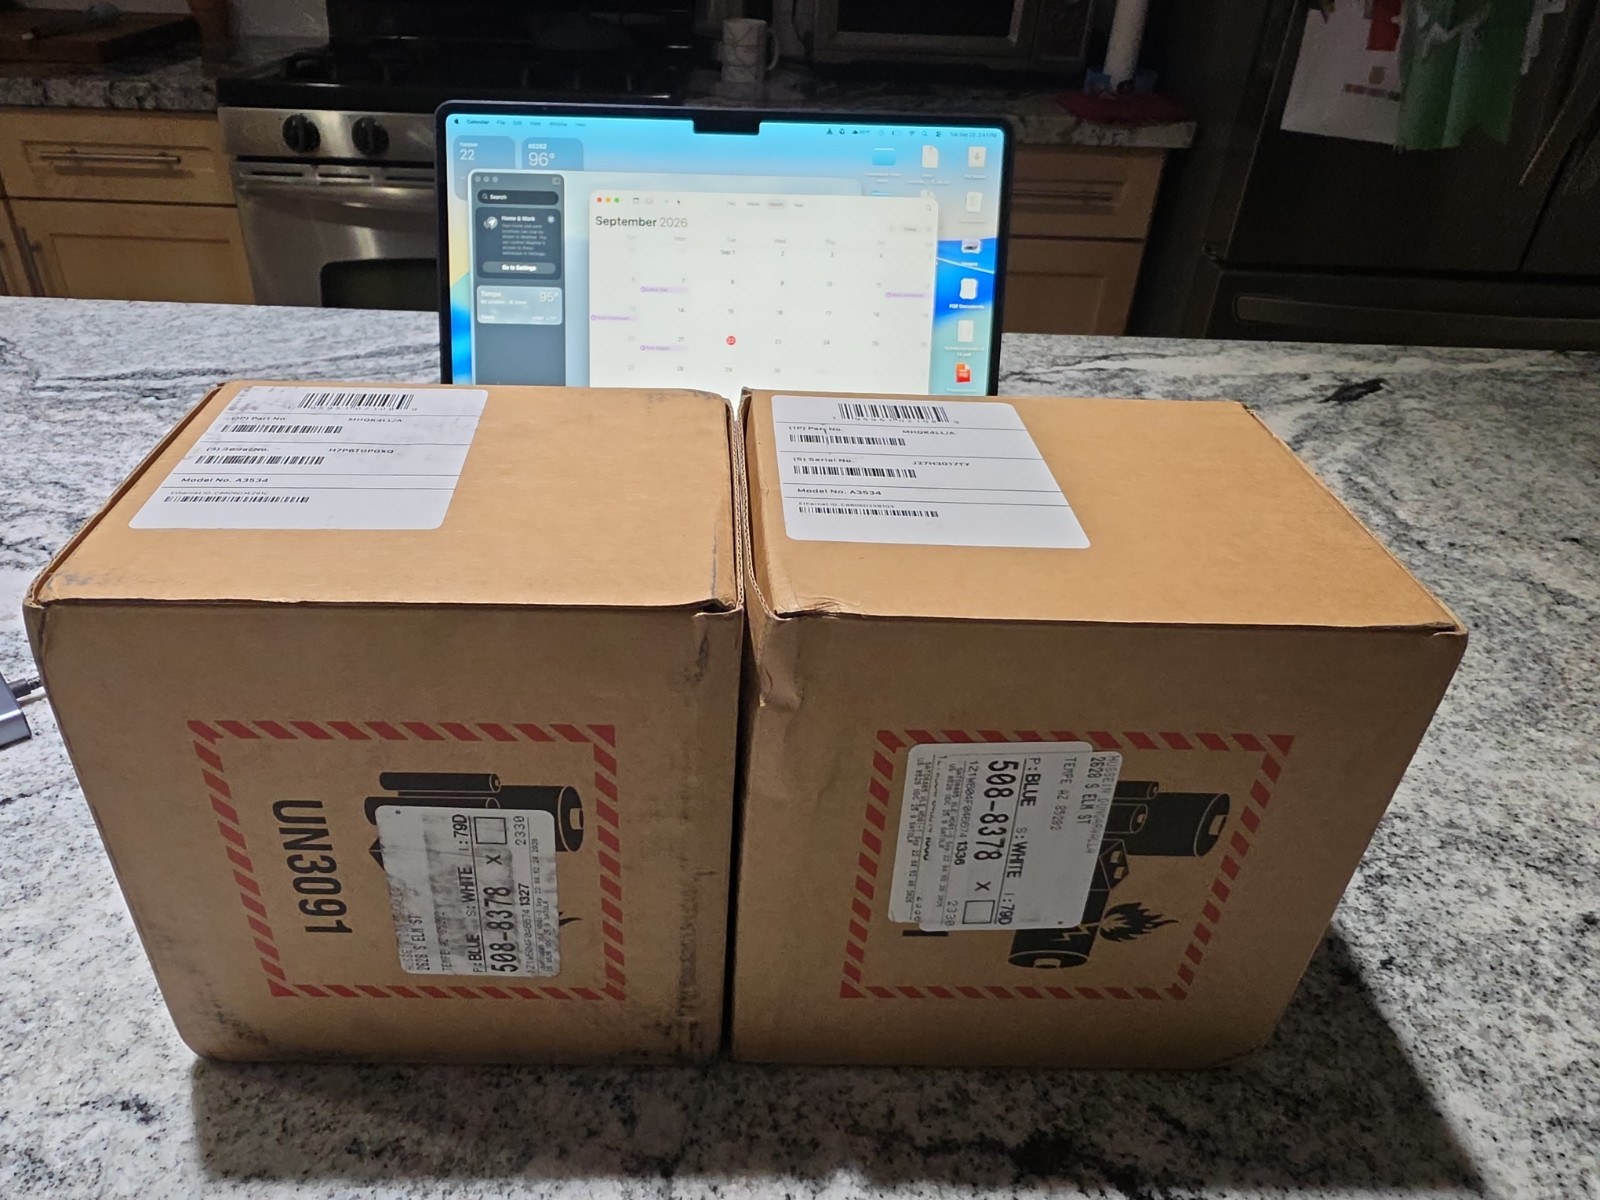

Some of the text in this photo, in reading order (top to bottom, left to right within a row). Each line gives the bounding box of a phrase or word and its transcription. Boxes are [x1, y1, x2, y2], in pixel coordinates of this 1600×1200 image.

[460, 149, 475, 160] 22
[528, 152, 555, 166] 96°
[595, 216, 688, 228] September 2026
[516, 264, 537, 272] Settings
[539, 291, 559, 302] 95°
[1086, 756, 1106, 778] 2628
[1048, 757, 1076, 830] TEMPE AZ 85282
[1079, 794, 1097, 809] ELM
[970, 760, 1021, 861] 508-8378
[1076, 814, 1091, 824] ST
[513, 815, 527, 845] 2330
[952, 840, 968, 865] 1336
[272, 799, 353, 934] UN3091
[518, 883, 530, 906] 1327
[409, 915, 422, 924] ST
[942, 900, 957, 926] 2330
[411, 927, 425, 941] ELM
[483, 887, 519, 972] 508-8378
[414, 953, 430, 971] 2628
